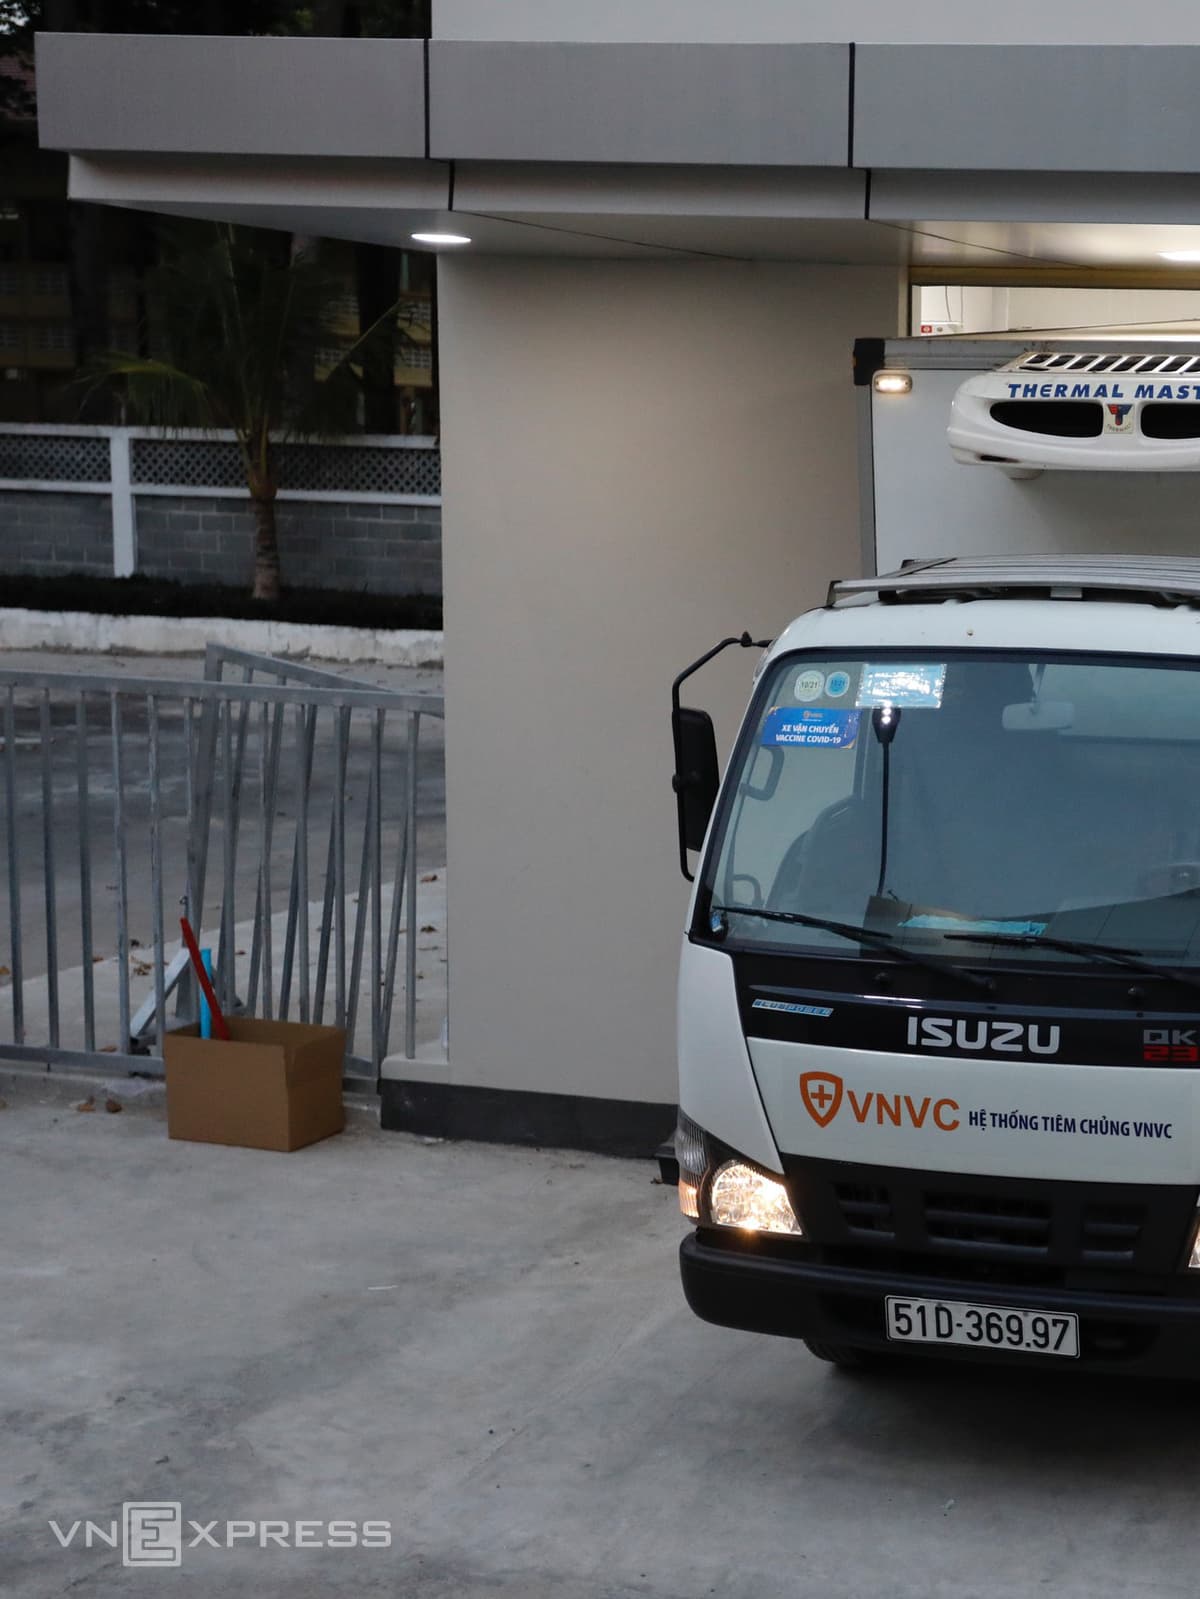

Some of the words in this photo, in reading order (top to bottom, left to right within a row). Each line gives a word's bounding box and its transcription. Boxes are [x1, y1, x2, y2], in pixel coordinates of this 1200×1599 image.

[1008, 383, 1124, 398] THERMAL
[776, 734, 806, 742] VACCINE
[807, 735, 841, 744] COVID-19
[907, 1016, 1060, 1054] ISUZU
[847, 1089, 960, 1132] VNVC
[968, 1109, 987, 1132] HỆ
[990, 1108, 1039, 1132] THỐNG
[1042, 1115, 1077, 1134] TIÊM
[1080, 1115, 1131, 1138] CHỦNG
[1134, 1121, 1173, 1140] VNVC
[894, 1302, 1070, 1351] 51D-369.97
